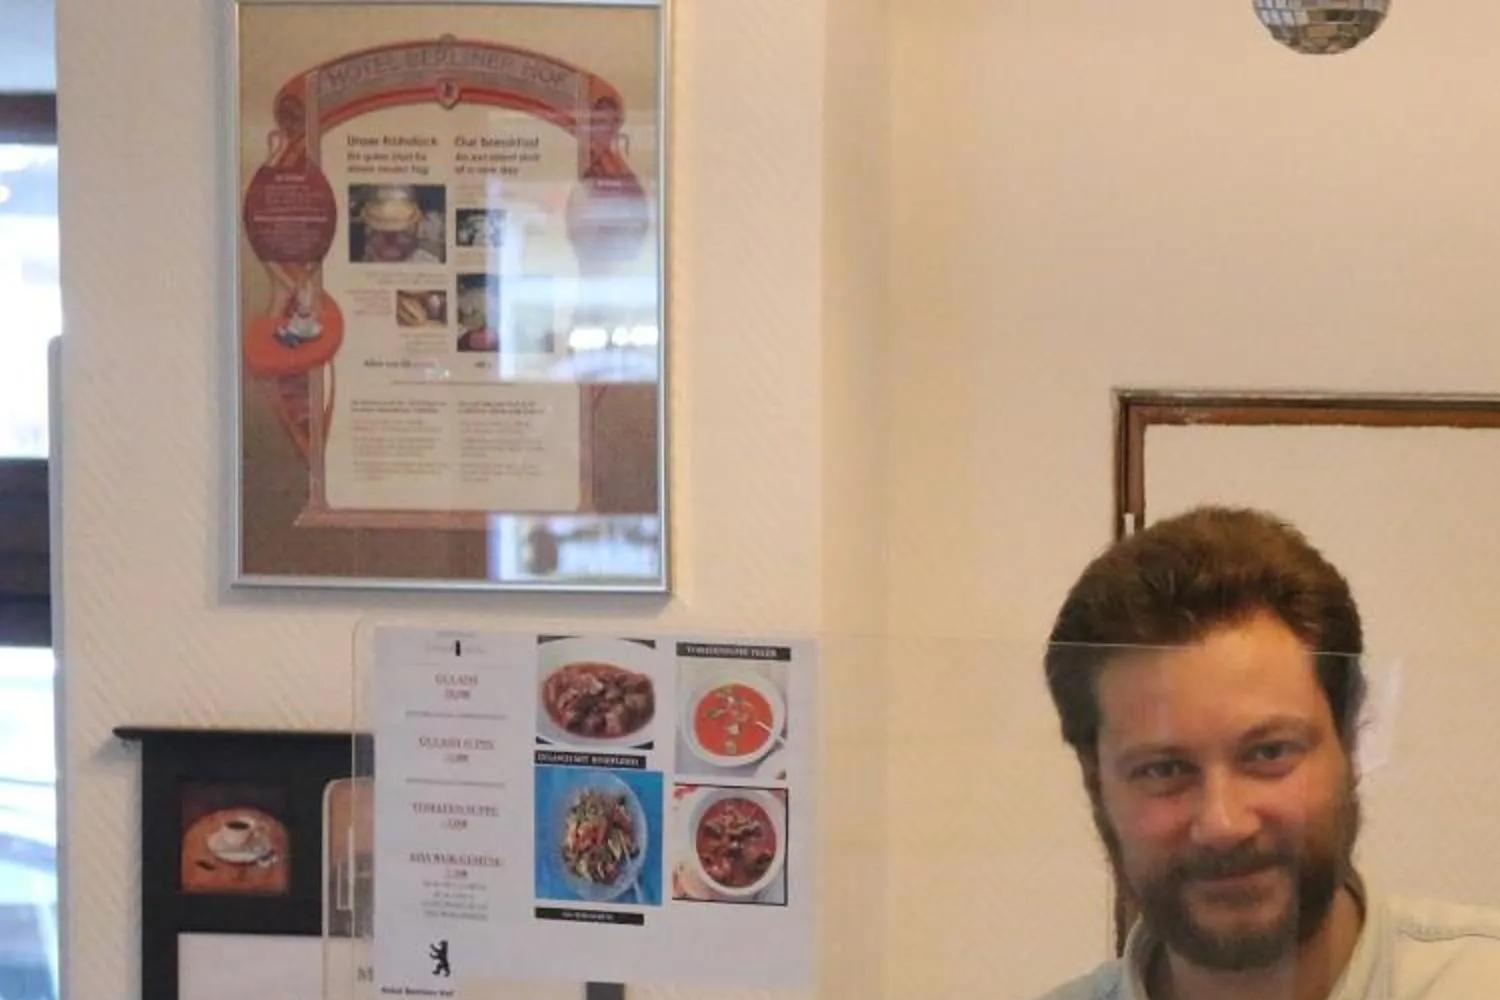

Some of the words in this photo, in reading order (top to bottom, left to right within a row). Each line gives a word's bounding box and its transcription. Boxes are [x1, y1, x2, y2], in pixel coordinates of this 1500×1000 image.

[327, 55, 399, 86] HOTEL
[405, 48, 514, 72] BERLINER
[522, 58, 568, 84] HOF
